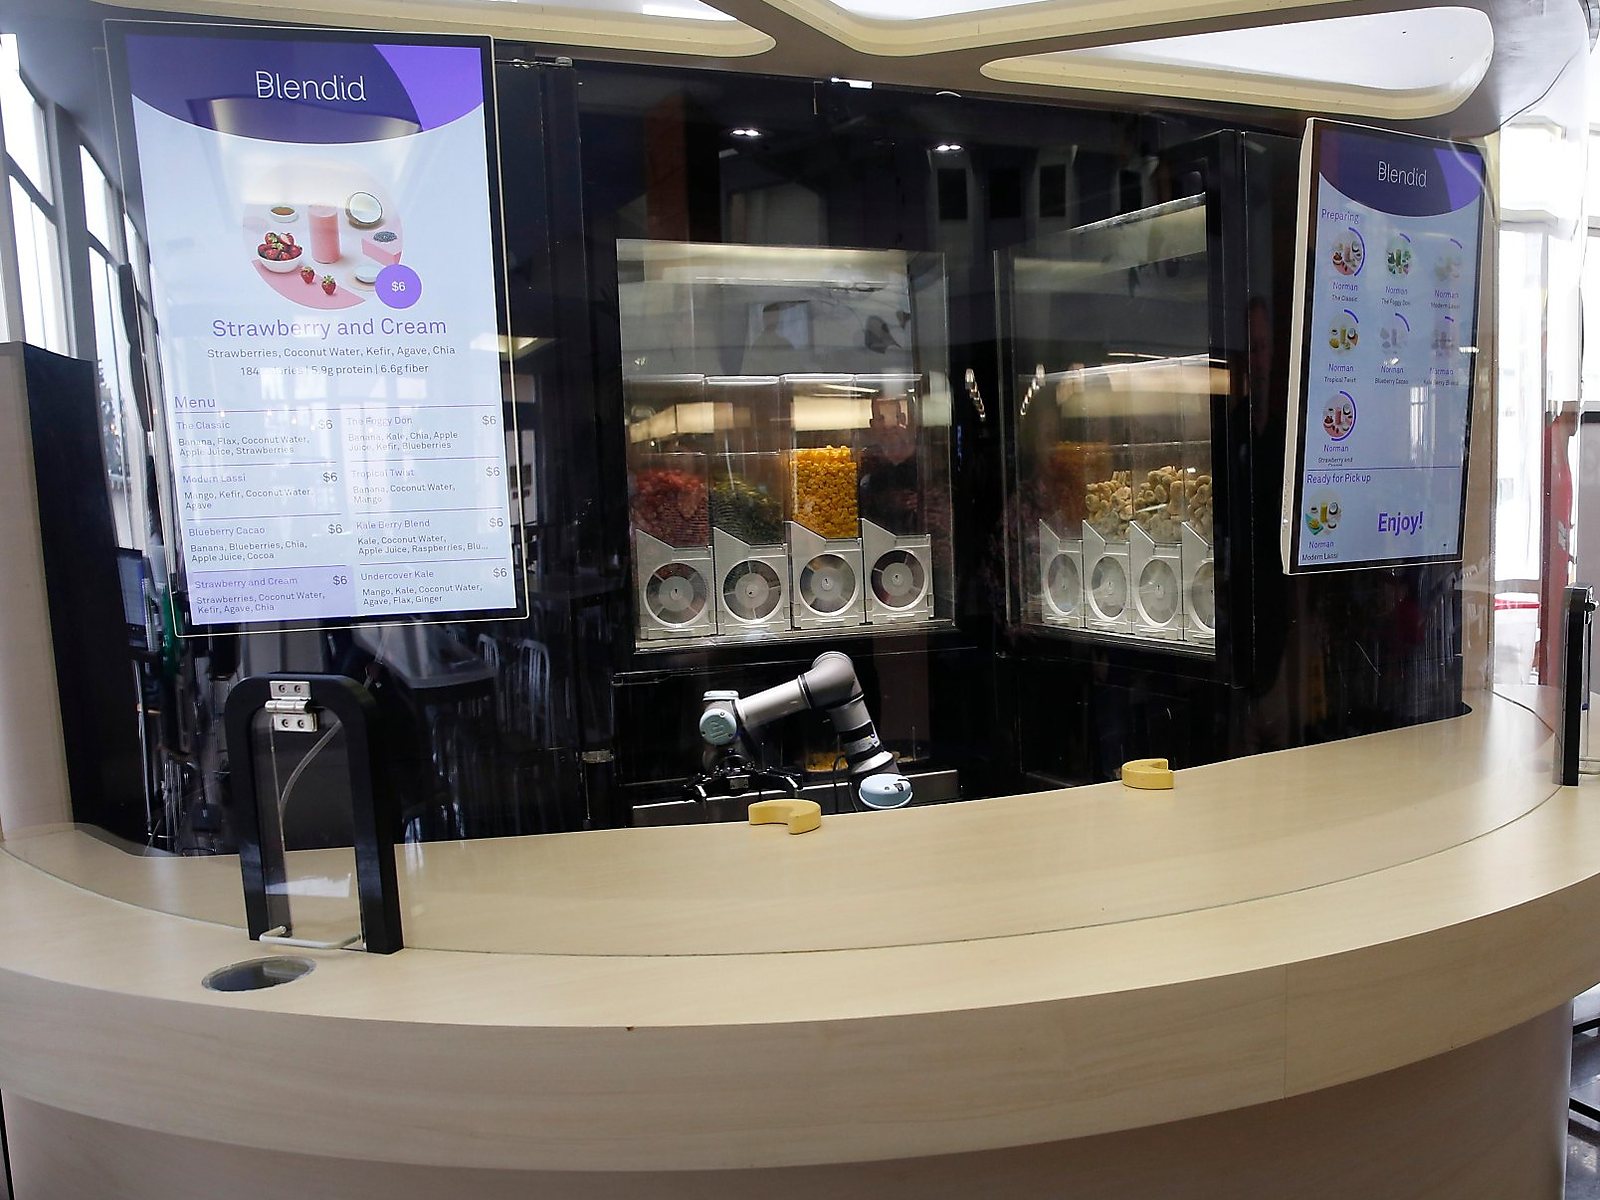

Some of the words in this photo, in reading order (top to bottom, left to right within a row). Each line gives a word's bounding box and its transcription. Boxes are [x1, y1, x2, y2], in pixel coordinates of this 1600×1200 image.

[256, 71, 367, 102] Blendid
[1378, 161, 1427, 188] Blendid
[1322, 209, 1359, 224] Preparing
[392, 280, 405, 293] $6
[1333, 282, 1358, 291] Norman
[1386, 286, 1407, 294] Norman
[1435, 290, 1459, 298] Norman
[213, 319, 331, 340] Strawberry
[338, 317, 375, 337] and
[381, 317, 447, 335] Cream
[207, 349, 281, 359] Strawberries,
[284, 348, 326, 357] Coconut
[330, 347, 363, 357] Water,
[367, 346, 394, 357] Kefir,
[397, 346, 430, 357] Agave,
[433, 346, 455, 355] Chia
[241, 368, 259, 376] 184
[312, 365, 333, 376] 5.9g
[337, 365, 372, 376] protein
[381, 364, 403, 375] 6.6g
[405, 364, 429, 373] fiber
[1329, 364, 1354, 372] Norman
[175, 396, 215, 408] Menu
[318, 419, 333, 430] $6
[395, 417, 412, 425] Don
[482, 415, 496, 425] $6
[177, 421, 193, 430] The
[196, 421, 230, 429] Classic
[179, 438, 215, 446] Banana,
[242, 436, 279, 444] Coconut
[281, 436, 309, 444] Water,
[349, 434, 383, 442] Banana,
[410, 432, 431, 440] Chia,
[434, 432, 458, 440] Apple
[236, 446, 294, 455] Strawberries
[376, 443, 400, 451] Kefir,
[403, 441, 451, 449] Blueberries
[390, 469, 415, 477] Twist
[486, 467, 500, 477] $6
[323, 472, 337, 483] $6
[1307, 474, 1330, 485] Ready
[1333, 474, 1343, 482] for
[1345, 473, 1360, 482] Pick
[1362, 474, 1371, 484] up
[219, 490, 243, 498] Kefir,
[246, 489, 281, 497] Coconut
[353, 486, 388, 494] Banana,
[390, 484, 425, 492] Coconut
[356, 521, 376, 530] Kale
[379, 520, 401, 530] Berry
[404, 519, 430, 528] Blend
[490, 518, 503, 527] $6
[1378, 511, 1423, 536] Enjoy!
[189, 528, 234, 537] Blueberry
[236, 527, 265, 535] Cacao
[328, 524, 342, 534] $6
[358, 537, 379, 545] Kale,
[382, 536, 416, 544] Coconut
[419, 535, 446, 543] Water,
[1309, 541, 1334, 549] Norman
[191, 544, 226, 552] Banana,
[285, 541, 307, 549] Chia,
[358, 547, 382, 556] Apple
[385, 546, 410, 554] Juice,
[412, 543, 465, 553] Raspberries,
[192, 555, 217, 563] Apple
[361, 572, 412, 580] Undercover
[414, 570, 434, 578] Kale
[493, 568, 507, 577] $6
[194, 580, 246, 589] Strawberry
[249, 578, 265, 586] and
[268, 577, 298, 585] Cream
[333, 575, 347, 585] $6
[363, 588, 393, 597] Mango,
[396, 587, 416, 595] Kale,
[419, 585, 453, 593] Coconut
[455, 584, 483, 592] Water,
[197, 596, 257, 605] Strawberries,
[259, 593, 294, 601] Coconut
[297, 592, 325, 600] Water,
[363, 598, 390, 607] Agave,
[416, 596, 442, 604] Ginger
[198, 606, 221, 614] Kefir,
[224, 605, 253, 614] Agave,
